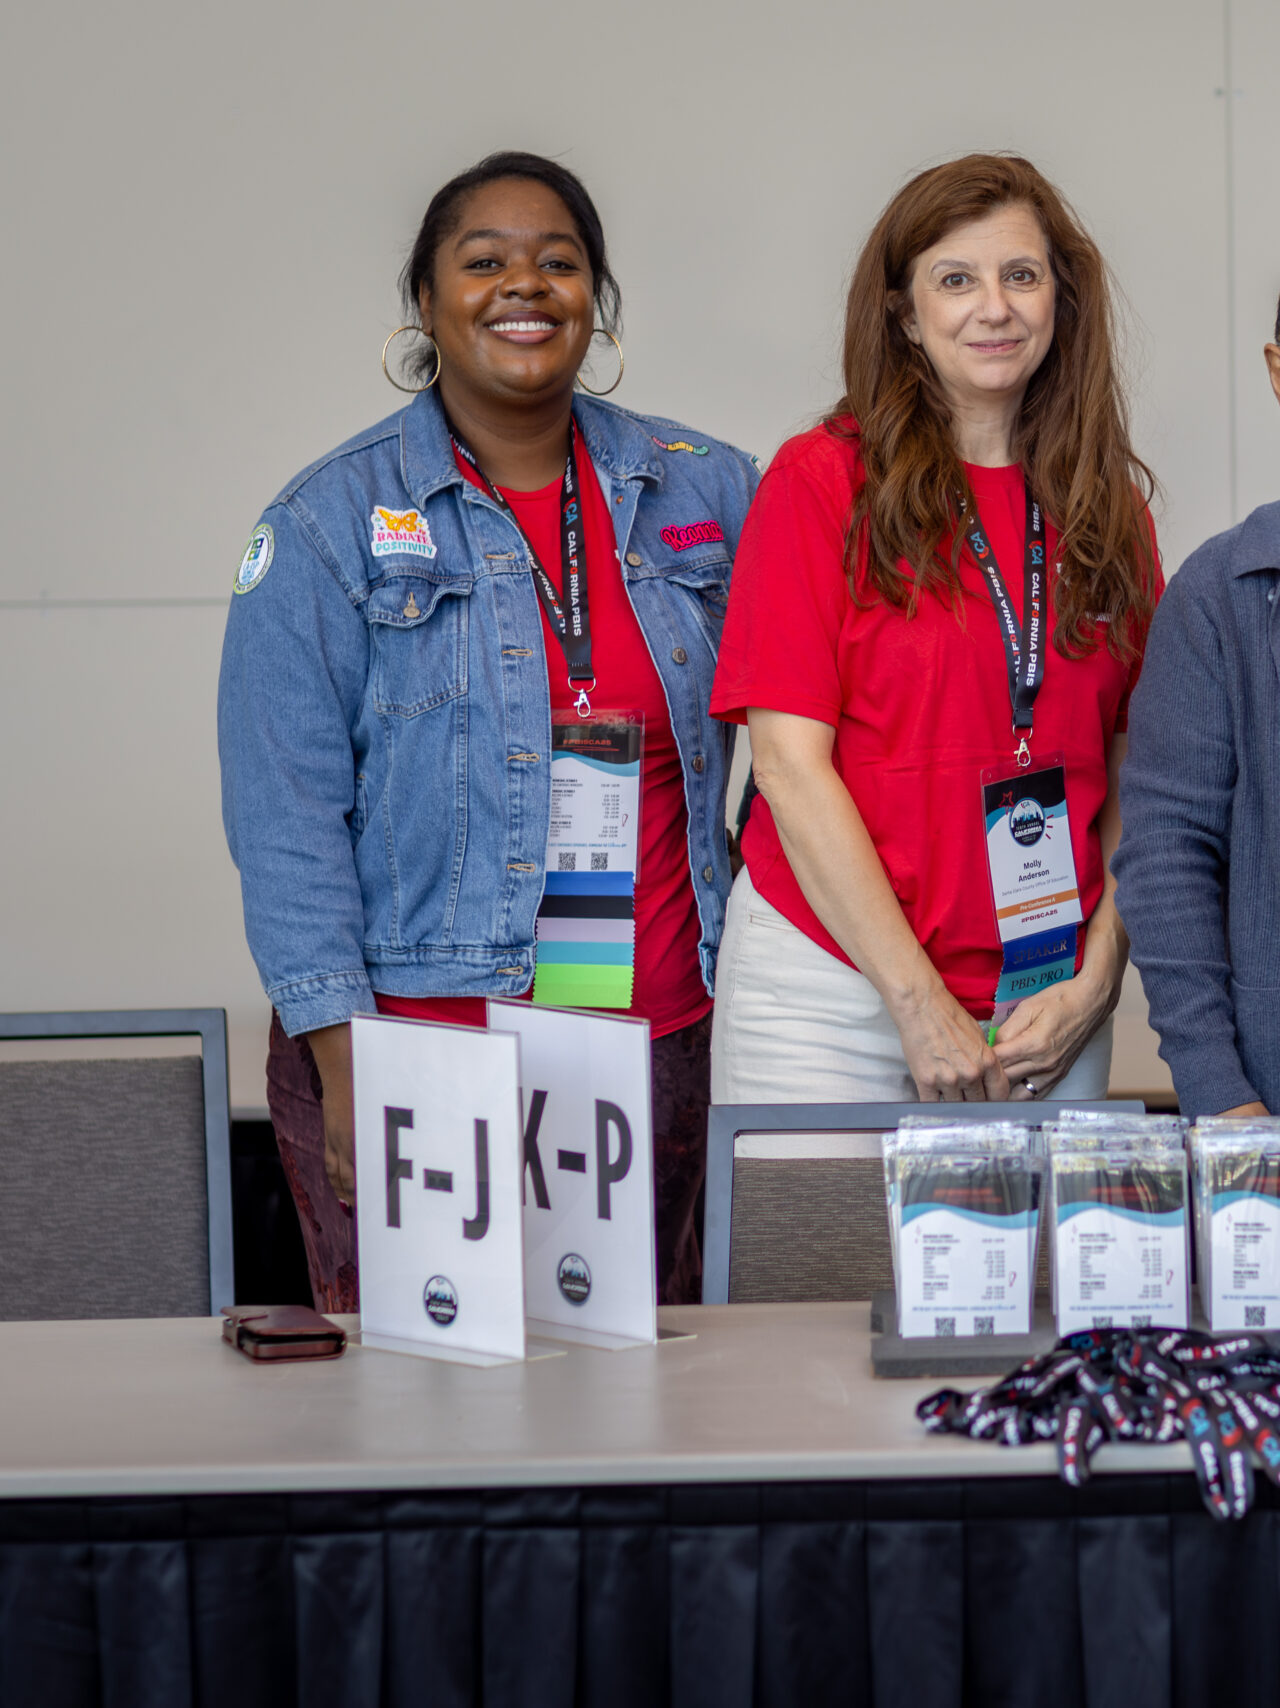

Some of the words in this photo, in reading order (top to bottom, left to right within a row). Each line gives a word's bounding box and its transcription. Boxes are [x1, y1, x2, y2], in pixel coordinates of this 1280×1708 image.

[1032, 502, 1040, 532] PBIS
[377, 531, 431, 546] RADIATE
[375, 541, 434, 556] POSITIVITY
[987, 566, 1004, 598] PBIS
[572, 607, 582, 637] PBIS
[1026, 653, 1037, 687] PBIS
[1023, 860, 1042, 871] Molly
[1018, 869, 1050, 882] Anderson
[1022, 884, 1035, 892] County
[1021, 909, 1058, 923] #PBISCA25
[1013, 939, 1068, 964] SPEAKER
[1010, 975, 1036, 991] PBIS
[1039, 967, 1064, 985] PRO
